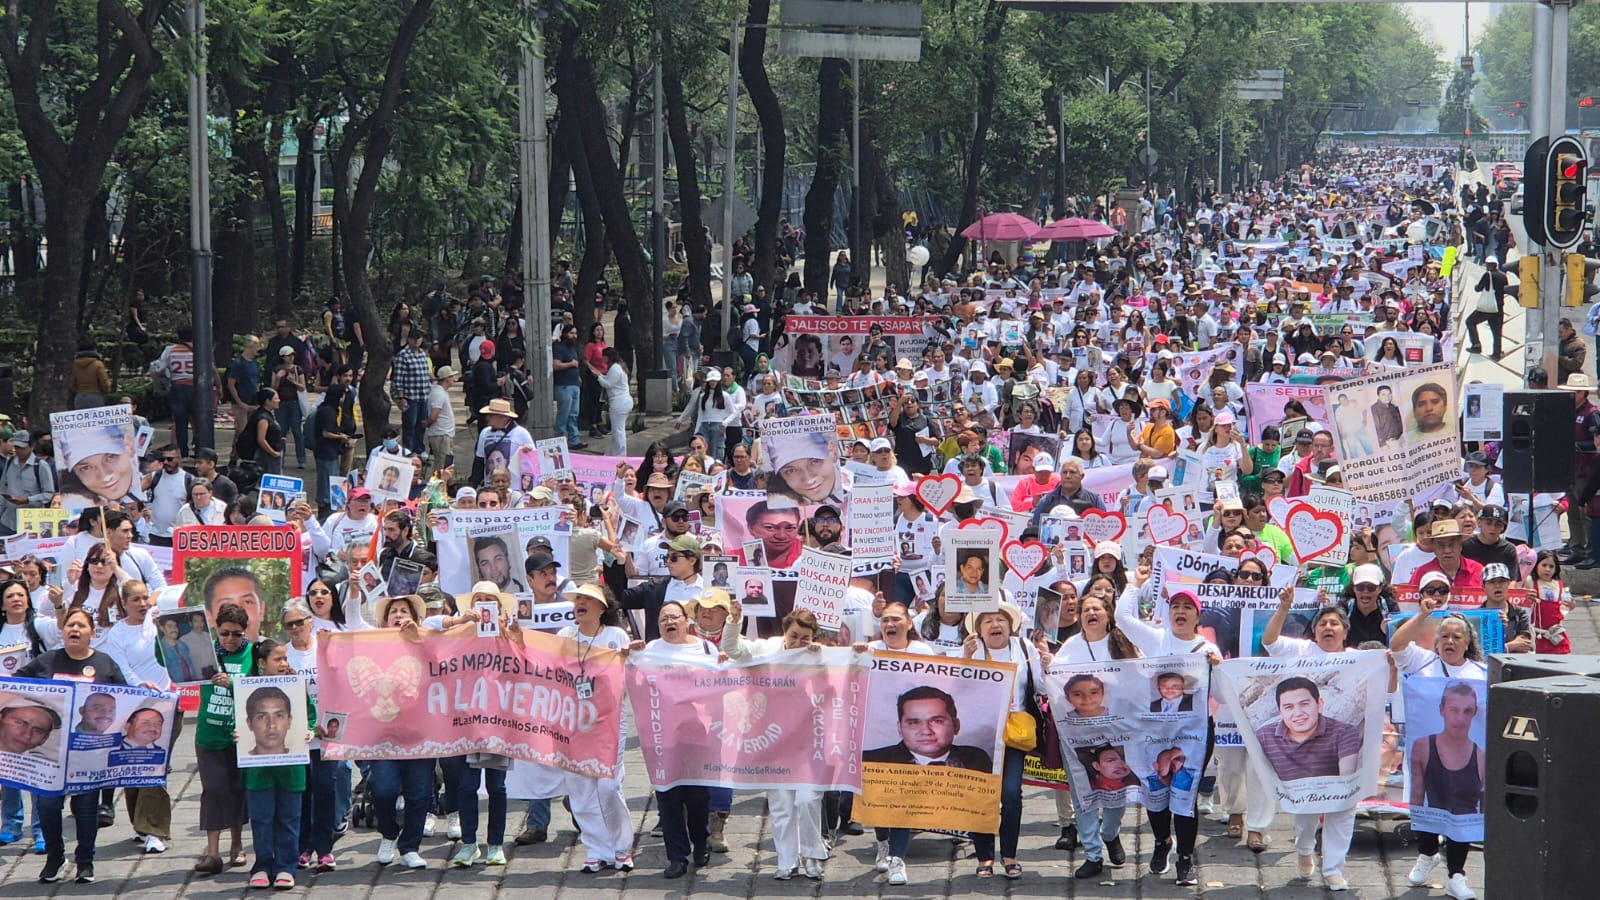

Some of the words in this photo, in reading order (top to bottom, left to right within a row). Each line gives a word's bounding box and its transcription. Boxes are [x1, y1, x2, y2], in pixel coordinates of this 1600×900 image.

[791, 319, 848, 331] JALISCO
[851, 320, 867, 331] TE
[1329, 380, 1364, 393] PEDRO
[1367, 370, 1415, 385] RAMÍREZ
[1275, 387, 1295, 397] SE
[54, 412, 90, 424] VICTOR
[92, 407, 128, 419] ADRIÁN
[97, 416, 130, 427] MORENO
[762, 419, 796, 431] VICTOR
[798, 416, 833, 427] ADRIÁN
[803, 424, 835, 433] MORENO
[1388, 451, 1406, 462] LOS
[1408, 436, 1457, 458] BUSCAMOS?
[1367, 468, 1385, 478] QUE
[1387, 463, 1404, 474] LOS
[1405, 450, 1442, 470] QUEREMOS
[455, 511, 550, 526] esaparecid
[470, 524, 512, 535] DESAPARECIDO
[178, 531, 296, 551] DESAPARECIDO
[951, 538, 994, 547] Desaparecido
[803, 555, 836, 571] ¿QUIÉN
[839, 563, 849, 574] TE
[799, 567, 847, 588] BUSCARÁ
[799, 579, 844, 599] CUANDO
[802, 595, 820, 606] ¿YO
[822, 598, 835, 611] YA
[1225, 600, 1246, 608] 2009
[429, 657, 458, 677] LAS
[462, 652, 520, 674] MADRES
[1249, 661, 1287, 674] Hugo
[240, 676, 297, 686] DESAPARECIDO
[694, 678, 712, 688] LAS
[713, 676, 750, 688] MADRES
[751, 675, 796, 688] LLEGARÁN
[91, 685, 172, 700] DESAPARECIDOS
[427, 682, 448, 715] A
[454, 676, 488, 712] LA
[495, 679, 598, 732] VERDAD
[831, 697, 844, 720] DE
[452, 713, 570, 745] #LasMadresNoSeRinden
[811, 693, 825, 761] MARCHA
[848, 681, 860, 775] DIGNIDAD
[1503, 716, 1540, 740] LA
[736, 722, 784, 754] VERDAD
[830, 732, 843, 756] LA
[703, 762, 791, 775] #LasMadresNoSeRinden
[863, 766, 885, 774] Jesús
[886, 767, 920, 776] Antonio
[921, 768, 945, 777] Mena
[946, 770, 988, 783] Contreras
[935, 780, 944, 788] de
[967, 784, 976, 792] de
[977, 787, 997, 796] 2010
